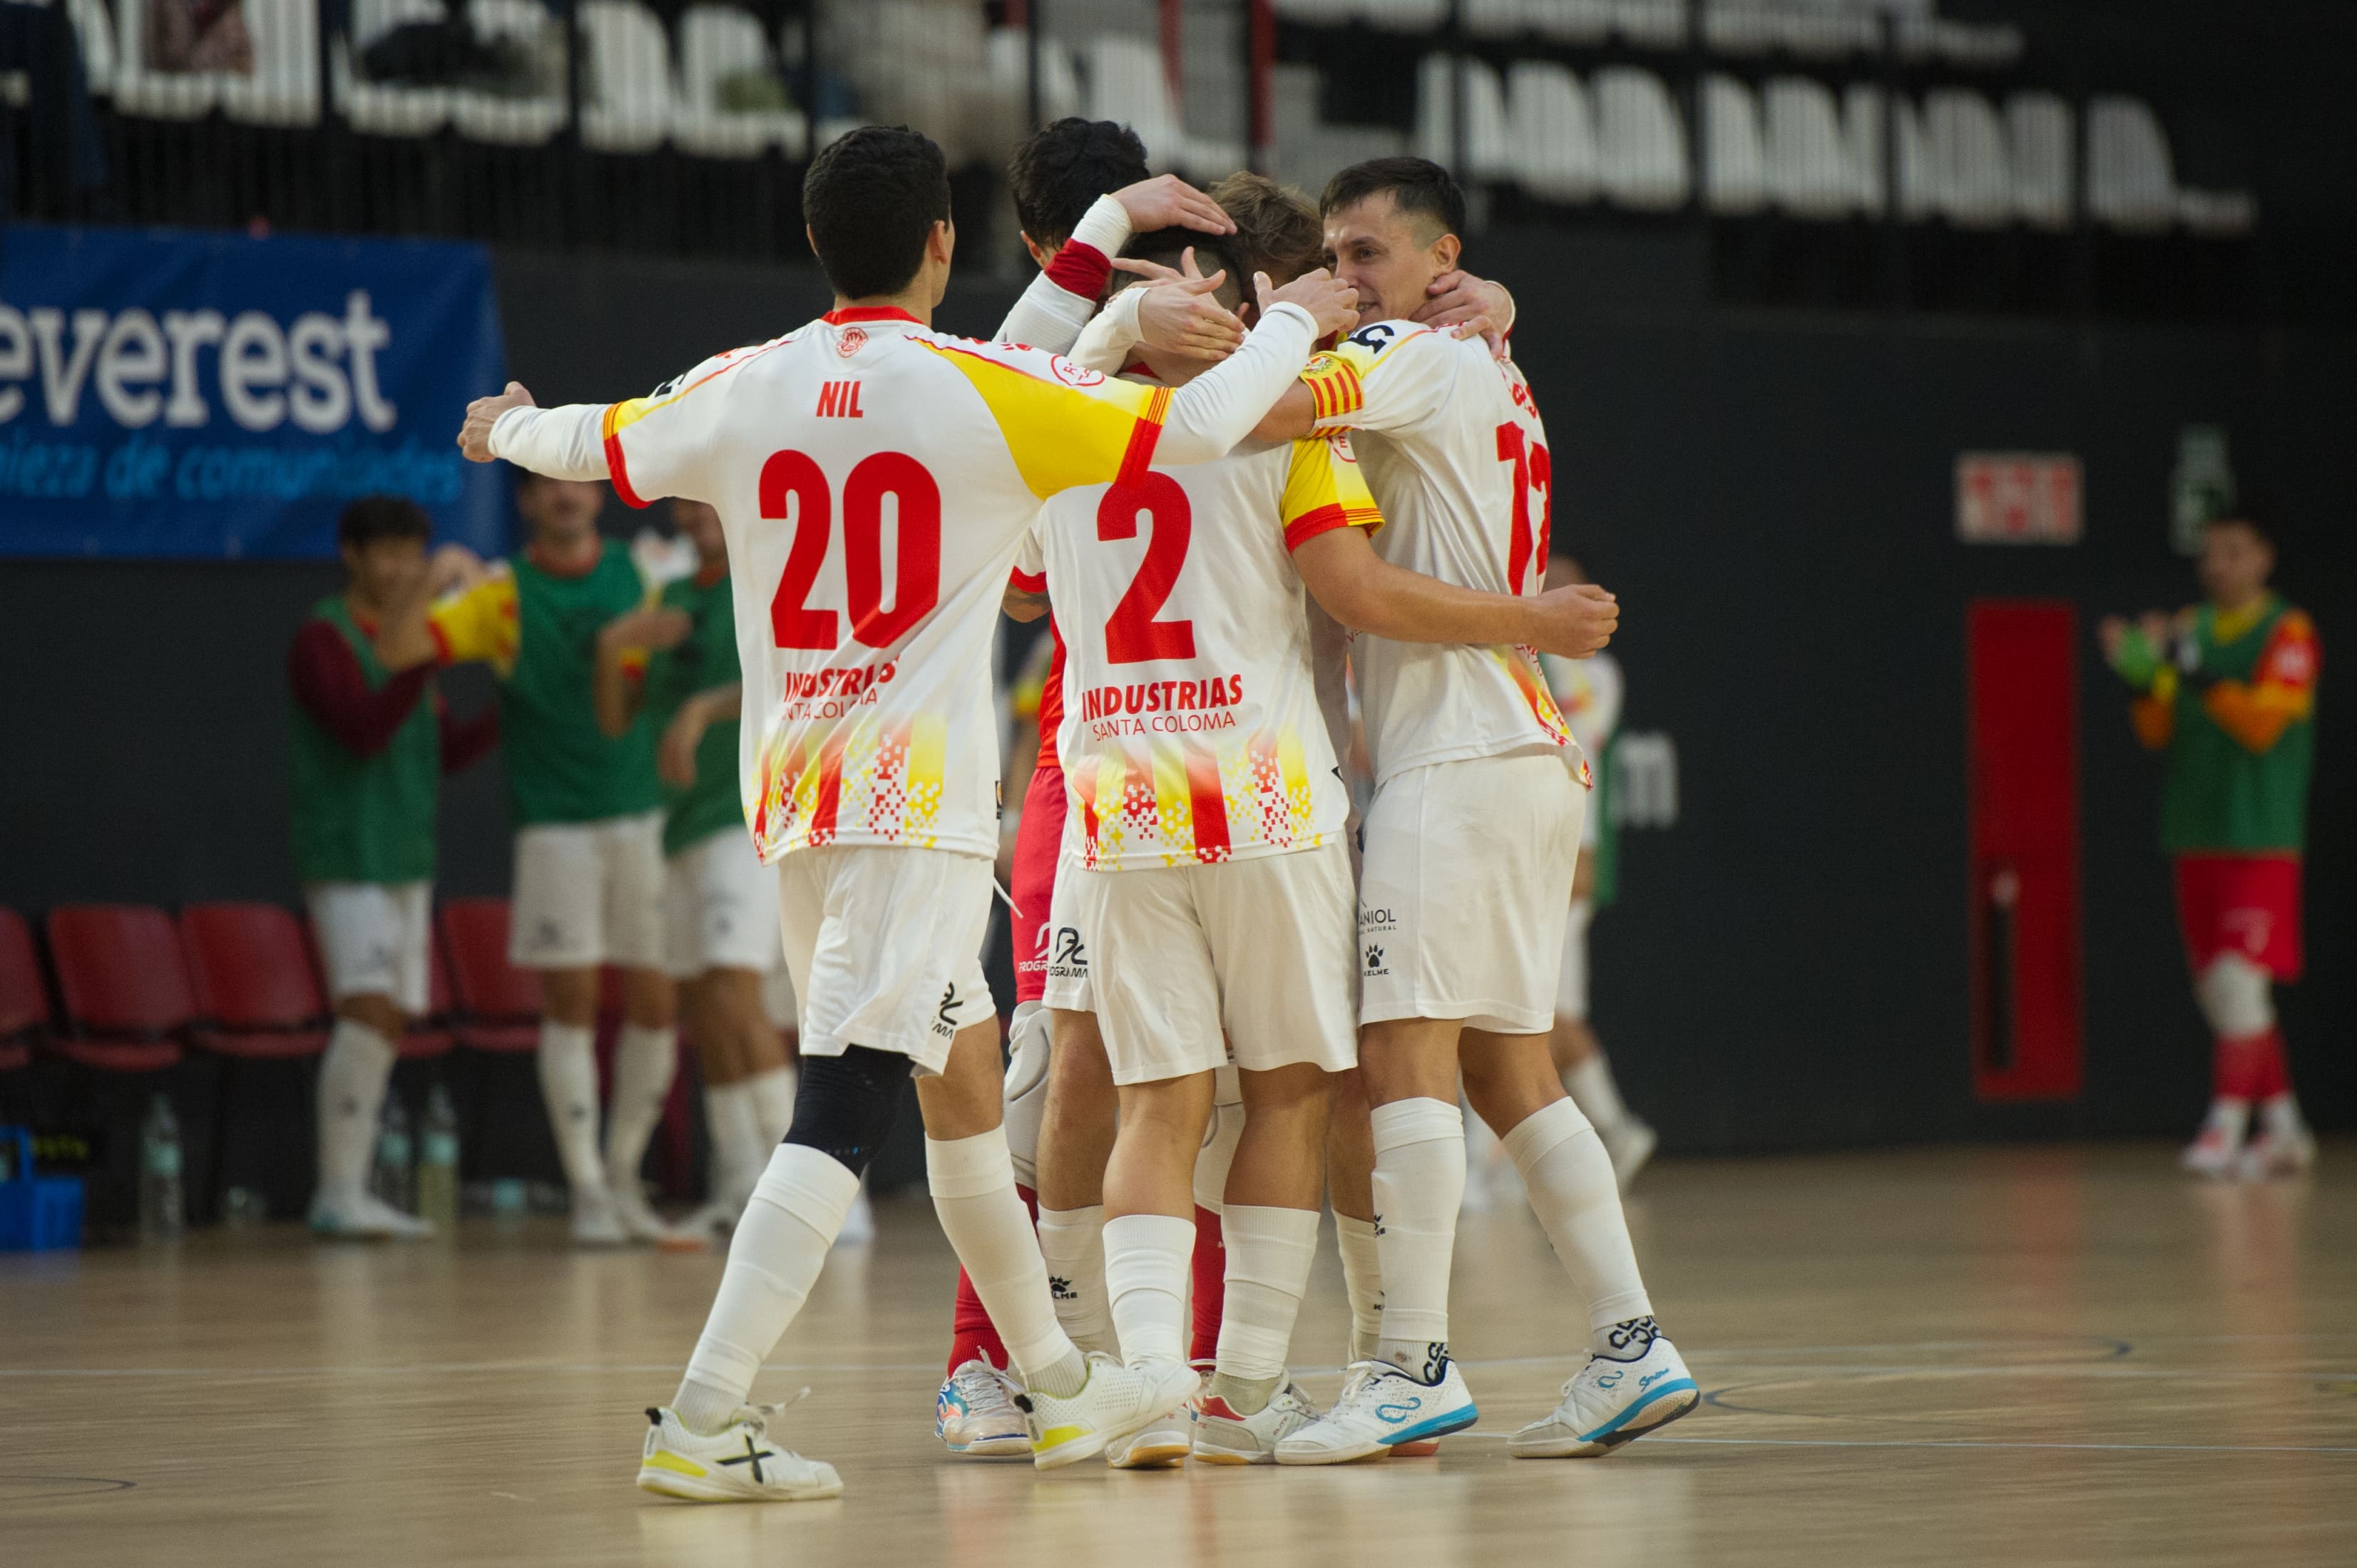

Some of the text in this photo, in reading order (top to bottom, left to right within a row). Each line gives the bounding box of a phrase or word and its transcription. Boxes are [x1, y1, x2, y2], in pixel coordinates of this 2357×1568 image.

[816, 381, 863, 418] NIL
[759, 449, 941, 650] 20
[1097, 471, 1196, 665] 2
[1082, 674, 1243, 722] INDUSTRIAS
[1093, 711, 1236, 741] SANTA COLOMA
